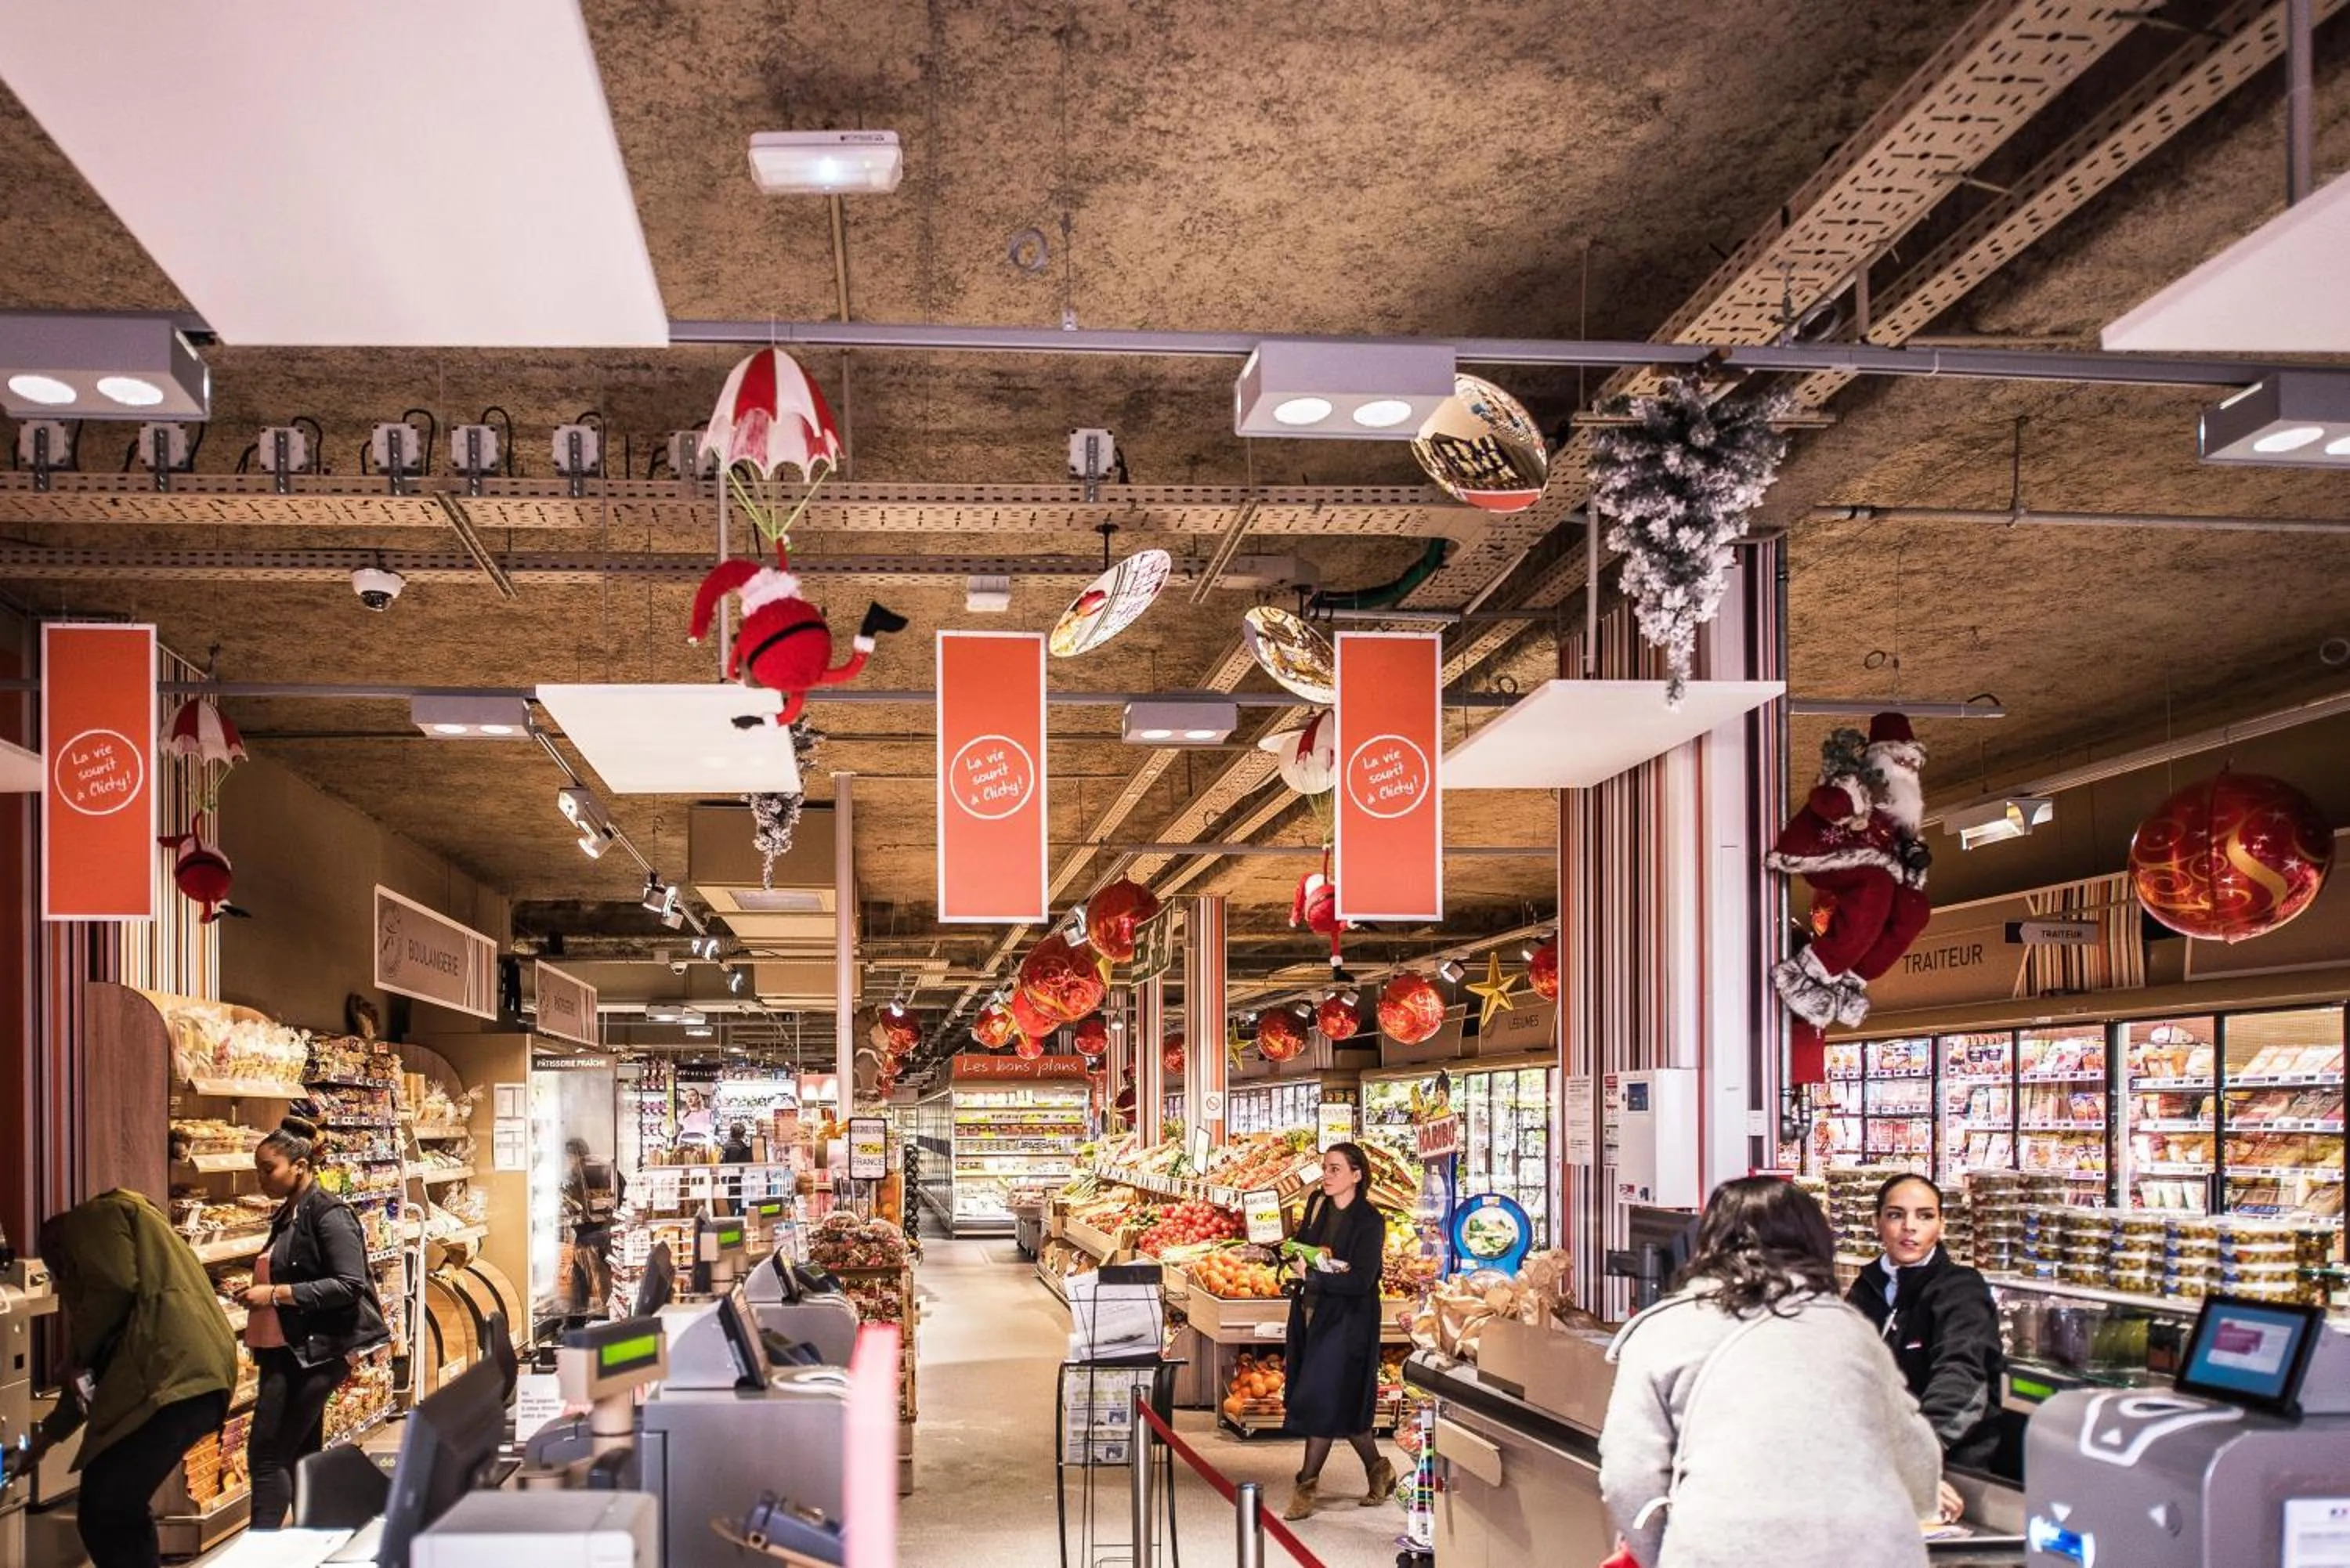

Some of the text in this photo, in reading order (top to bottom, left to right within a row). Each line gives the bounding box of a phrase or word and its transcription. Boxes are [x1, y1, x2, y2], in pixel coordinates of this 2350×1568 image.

[71, 743, 112, 765] La vie
[966, 747, 1004, 771] La vie
[1363, 747, 1401, 770] La vie
[78, 756, 116, 781] sourit
[972, 761, 1009, 786] sourit
[1368, 761, 1405, 784] sourit
[2041, 929, 2084, 938] TRAITEUR
[408, 938, 460, 977] BOULANGERIE
[1904, 944, 1983, 974] TRAITEUR
[963, 1058, 1078, 1077] Les bons plans
[1419, 1120, 1455, 1154] HARIBO
